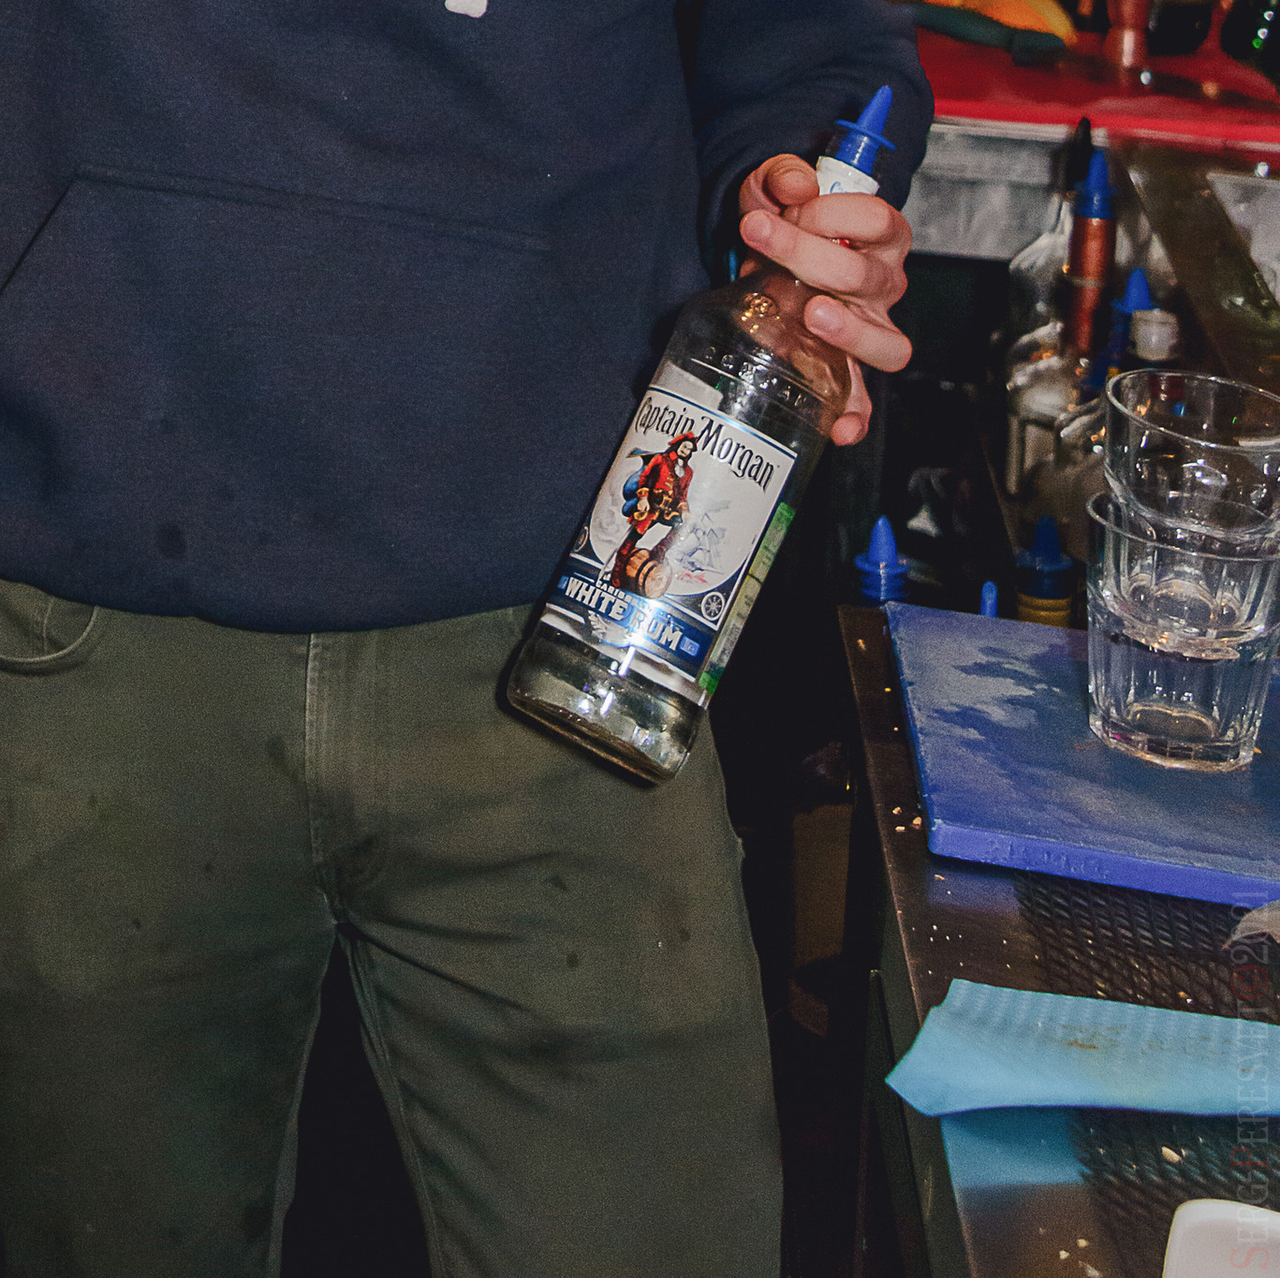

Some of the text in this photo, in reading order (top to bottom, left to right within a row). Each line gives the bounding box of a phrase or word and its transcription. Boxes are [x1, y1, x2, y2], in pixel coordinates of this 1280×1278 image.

[634, 396, 775, 493] Captain Morgan
[564, 576, 629, 621] WHITE
[630, 611, 684, 652] RUM
